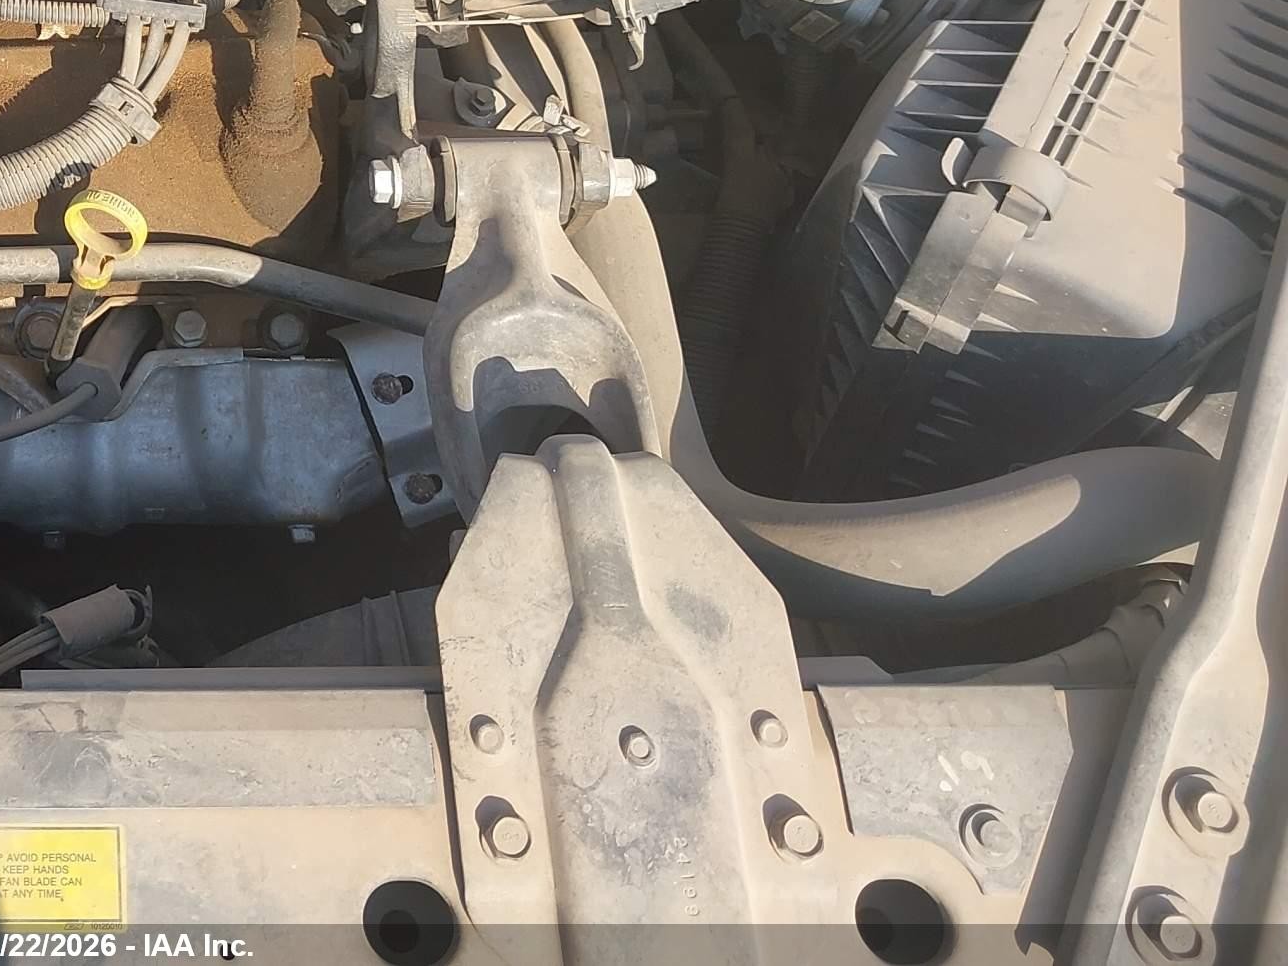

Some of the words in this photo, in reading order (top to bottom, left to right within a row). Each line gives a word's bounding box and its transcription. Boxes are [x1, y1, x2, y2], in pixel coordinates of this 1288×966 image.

[6, 852, 39, 863] AVOID
[41, 852, 97, 863] PERSONAL
[2, 864, 30, 875] KEEP
[33, 864, 70, 875] HANDS
[0, 876, 20, 887] FAN
[23, 876, 57, 887] BLADE
[60, 876, 83, 887] CAN
[13, 888, 34, 899] ANY
